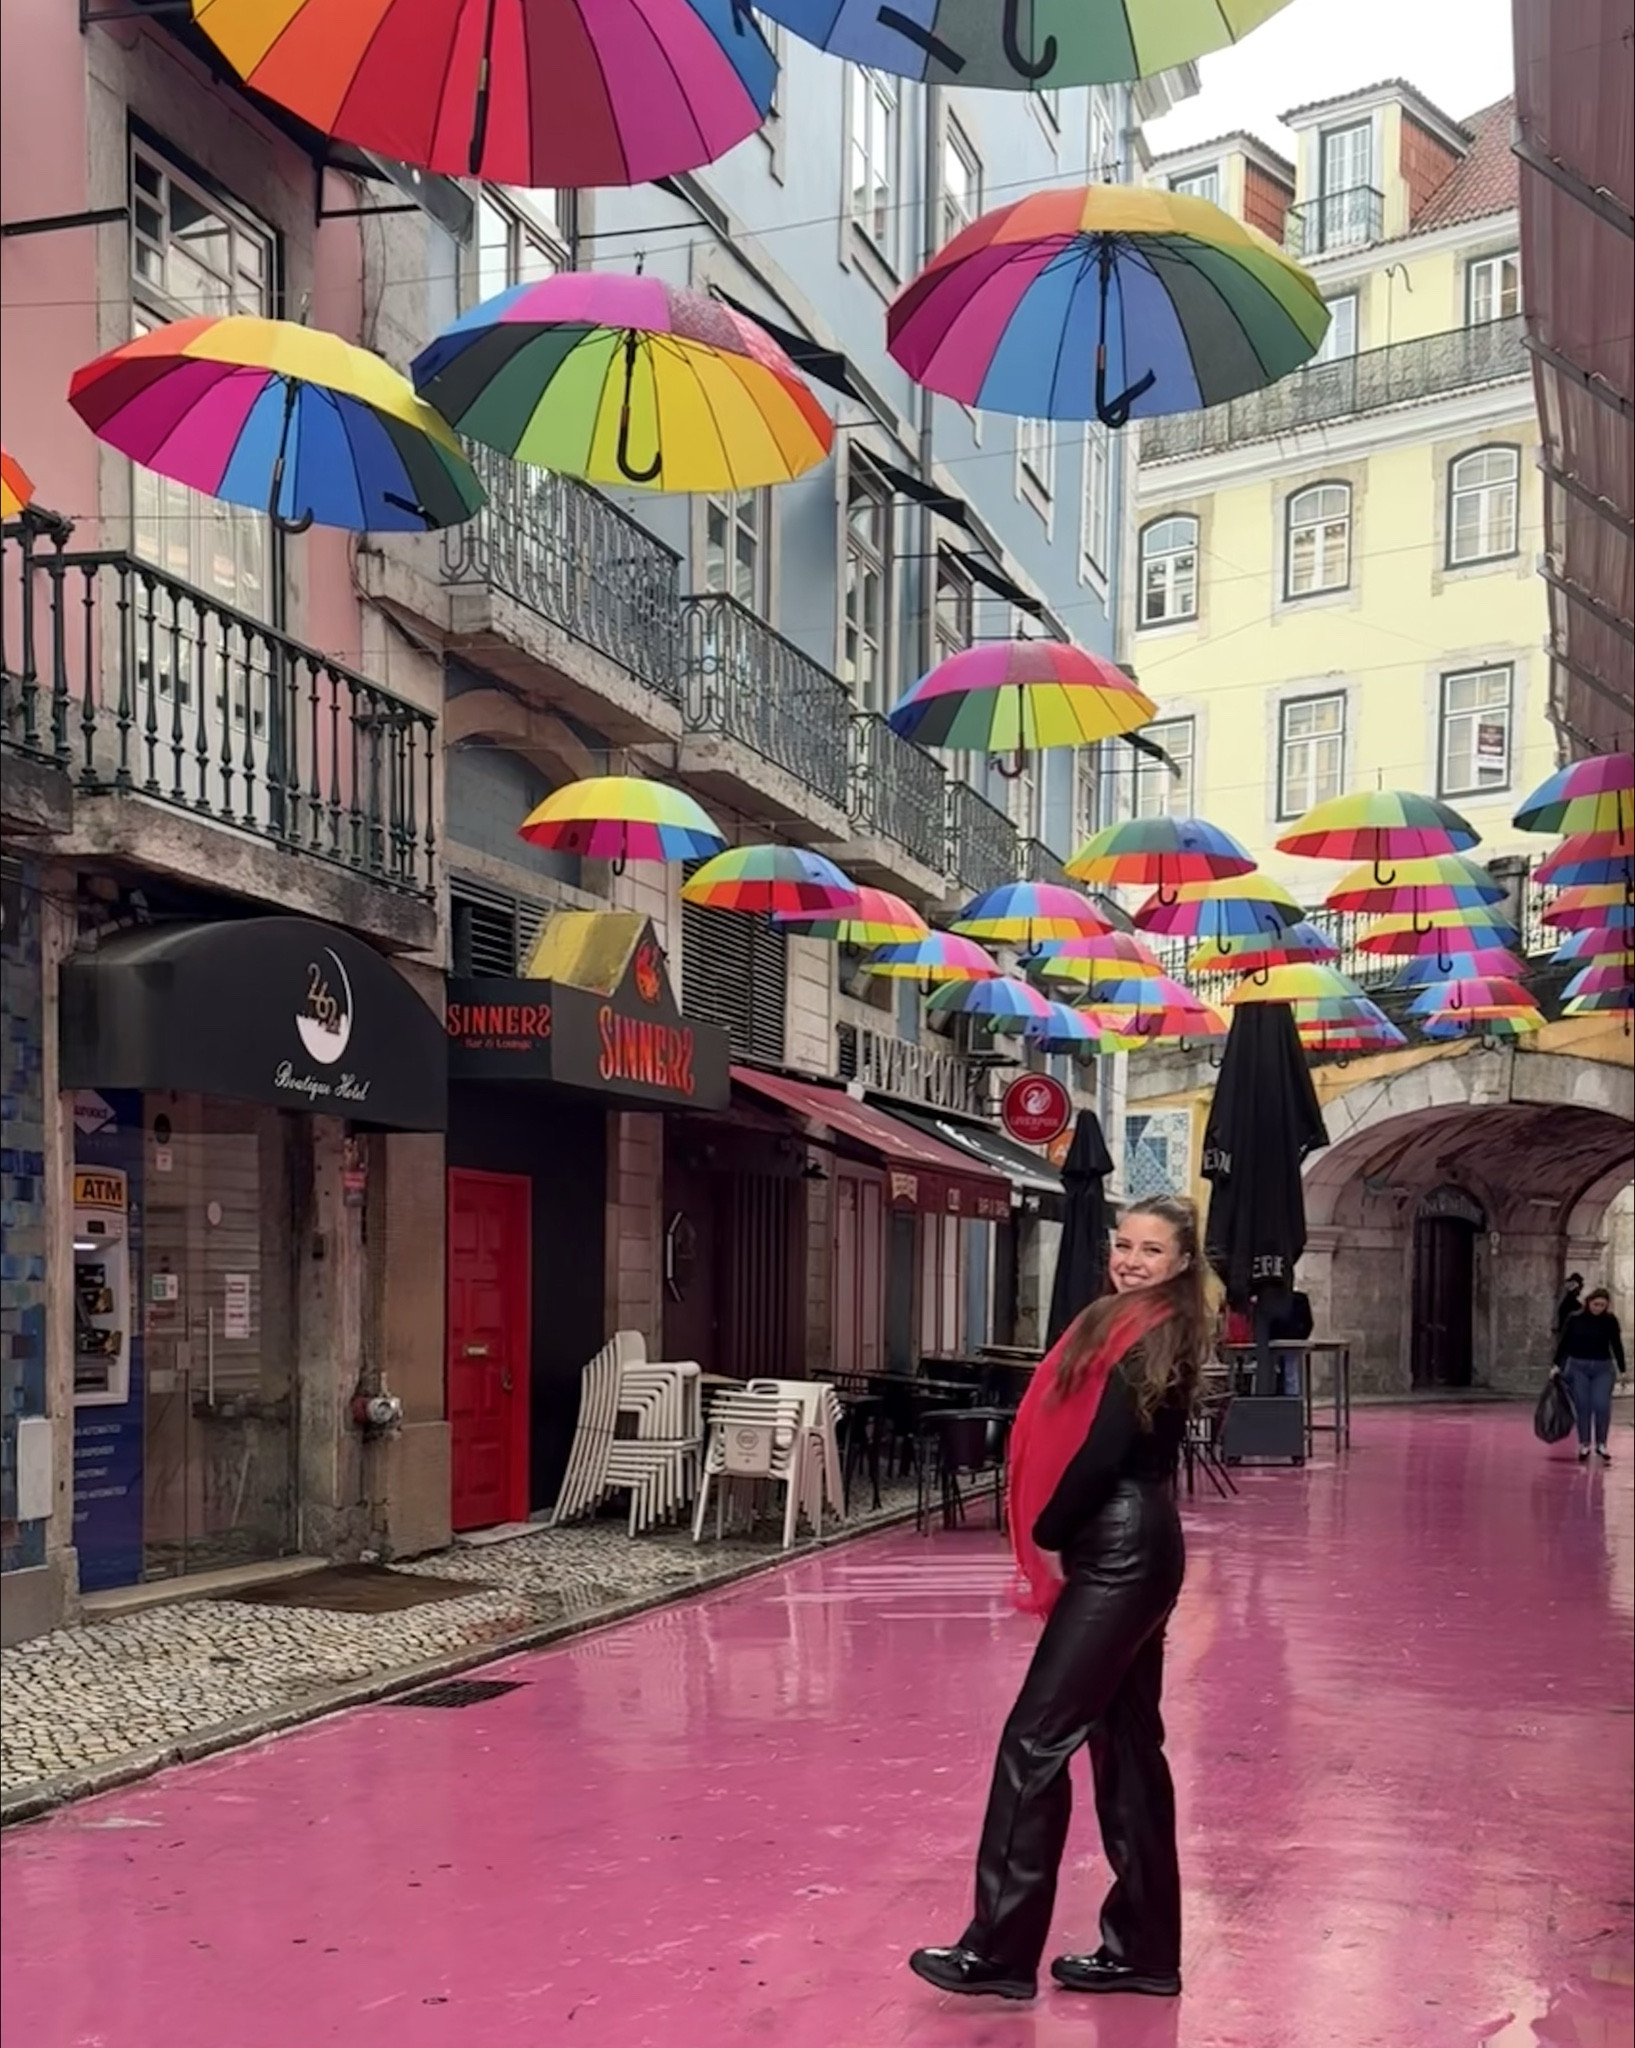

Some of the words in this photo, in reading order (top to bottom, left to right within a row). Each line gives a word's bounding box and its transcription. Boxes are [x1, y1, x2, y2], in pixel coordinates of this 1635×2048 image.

[447, 1004, 551, 1037] SINNERS
[599, 1005, 694, 1095] SINNERS
[274, 1060, 331, 1101] Boutique
[334, 1072, 371, 1100] Hotel
[82, 1178, 123, 1201] ATM
